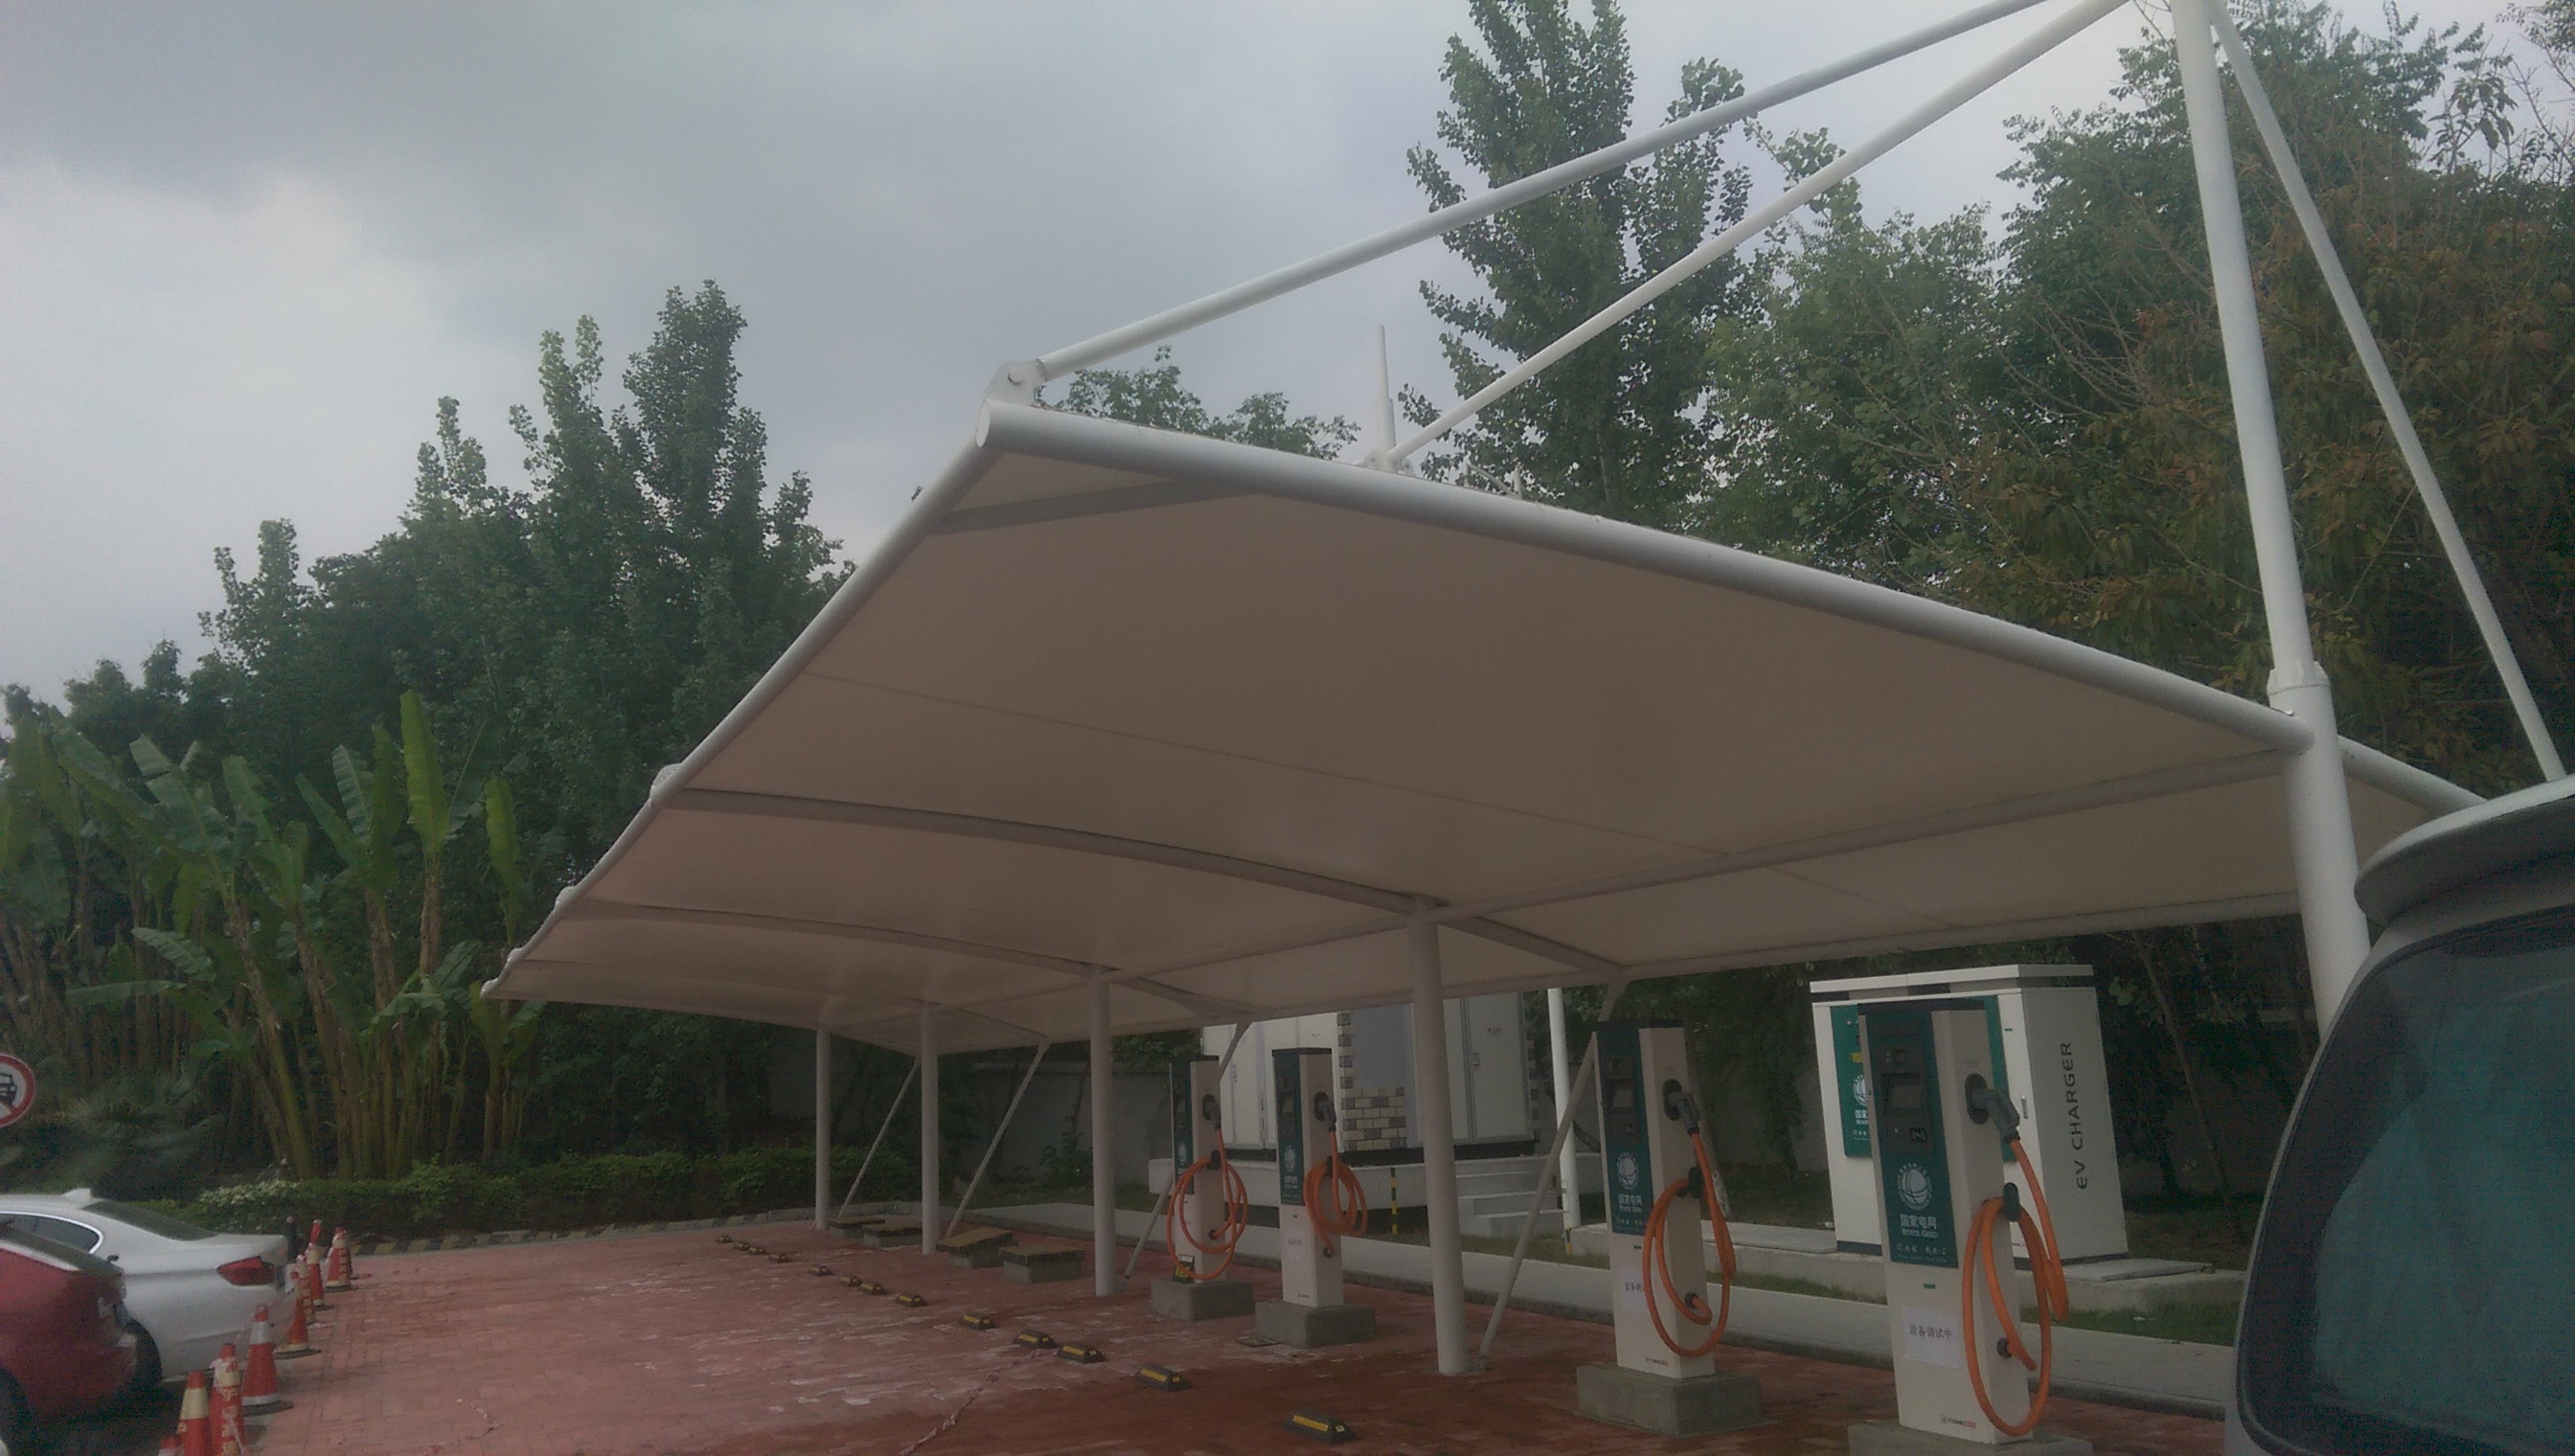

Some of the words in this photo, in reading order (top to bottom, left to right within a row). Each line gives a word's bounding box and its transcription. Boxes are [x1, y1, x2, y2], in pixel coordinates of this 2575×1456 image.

[2062, 1042, 2084, 1150] CHARGER
[2075, 1160, 2087, 1190] EV
[1900, 1214, 1937, 1230] 国家电网
